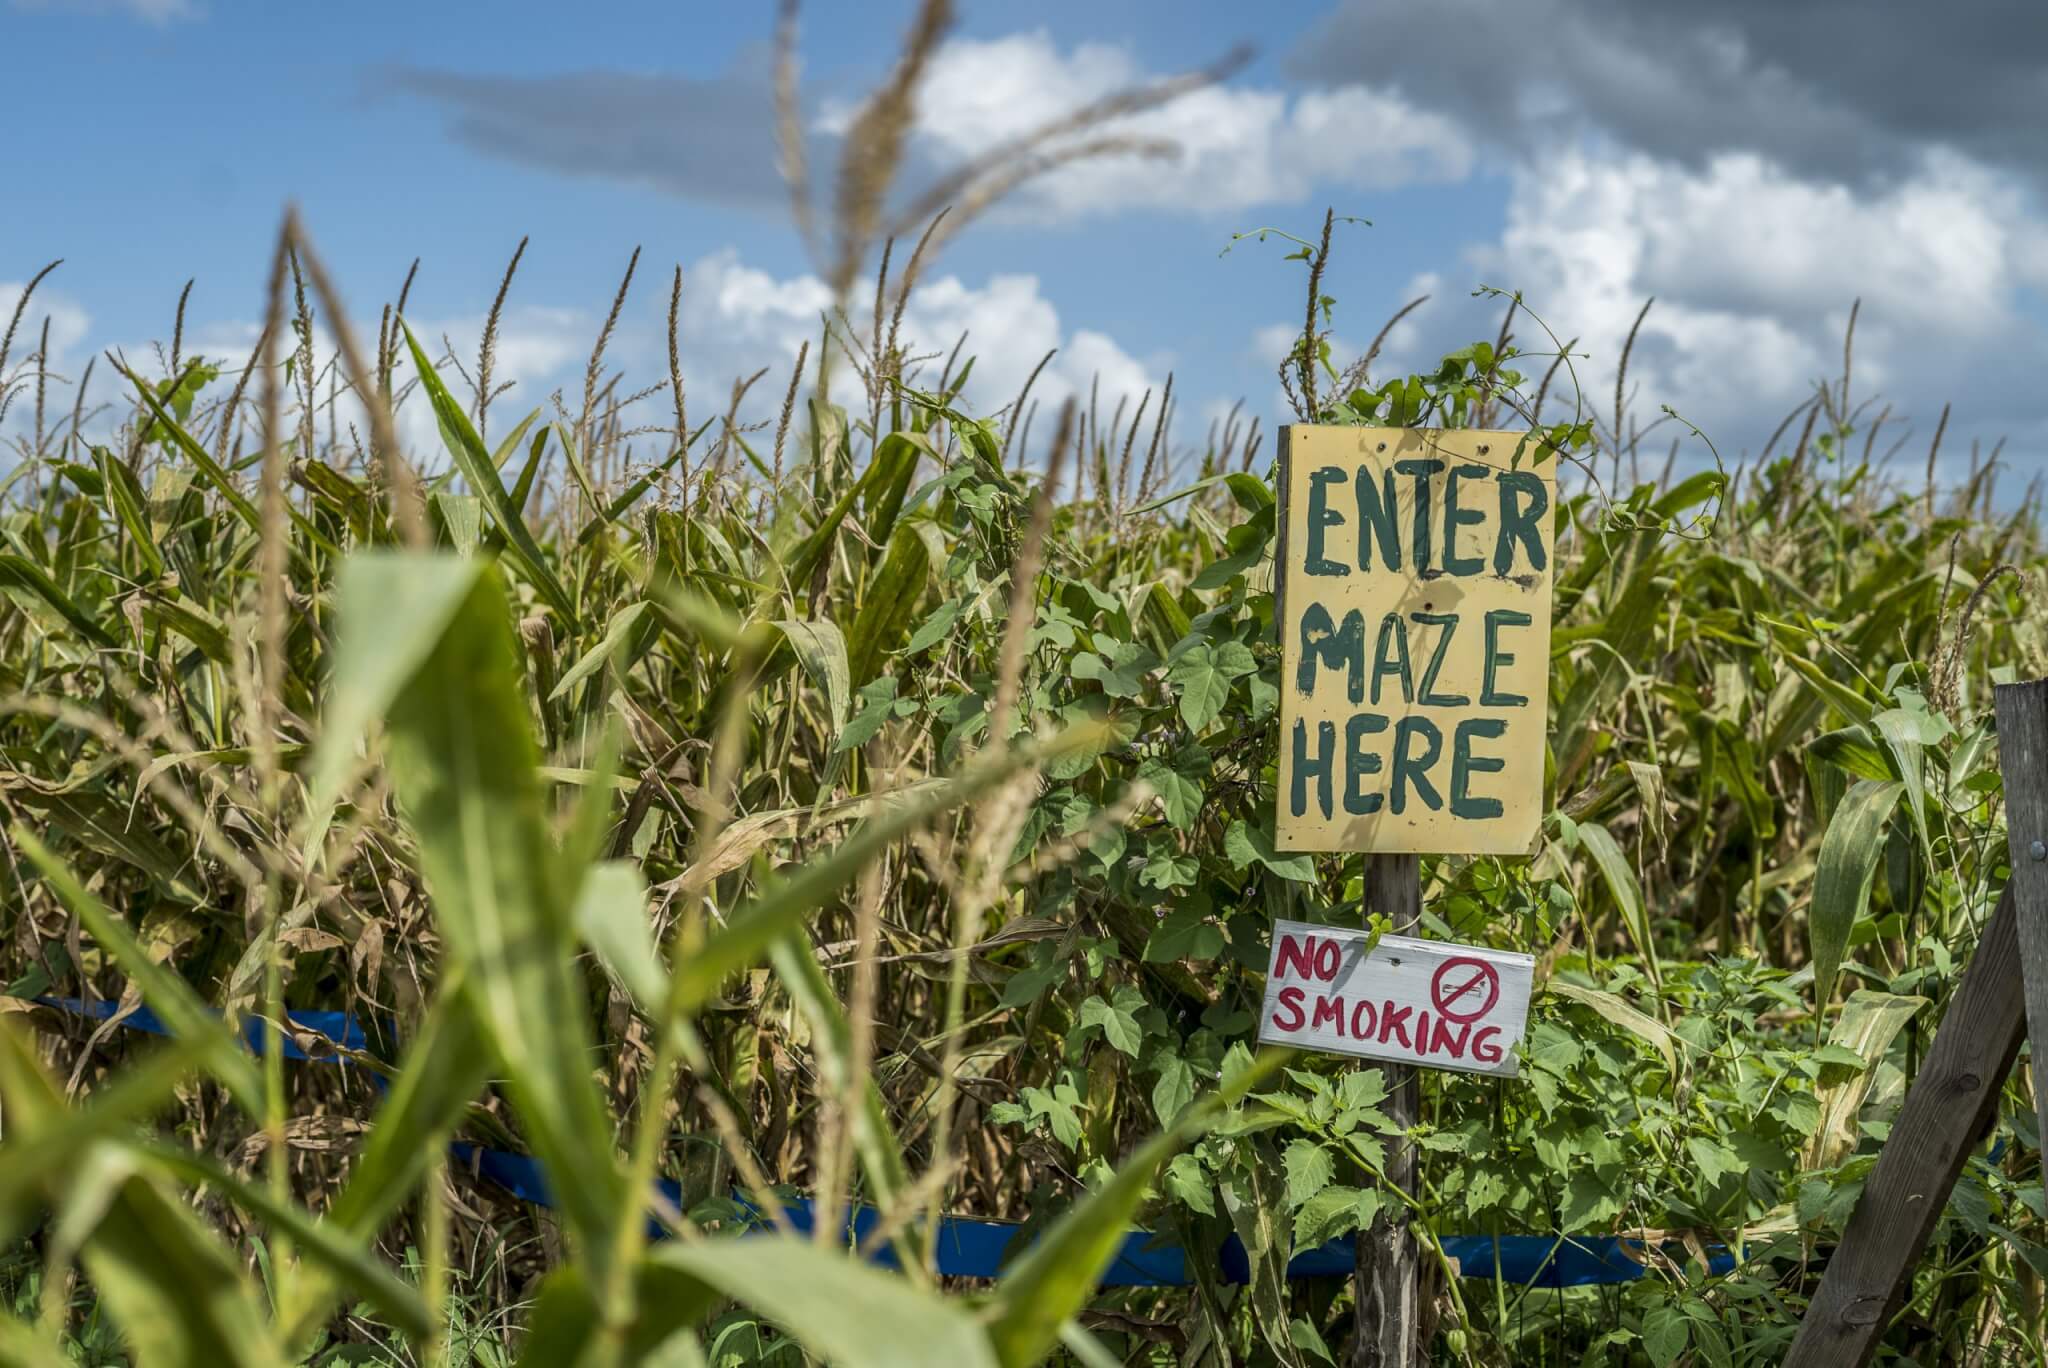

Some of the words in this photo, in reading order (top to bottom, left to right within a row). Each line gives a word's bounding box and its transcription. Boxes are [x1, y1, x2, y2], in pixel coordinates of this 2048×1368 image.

[1303, 459, 1549, 580] ENTER
[1296, 602, 1532, 707] MAZE
[1290, 713, 1508, 820] HERE
[1274, 935, 1341, 982] NO
[1272, 987, 1503, 1063] SMOKING
